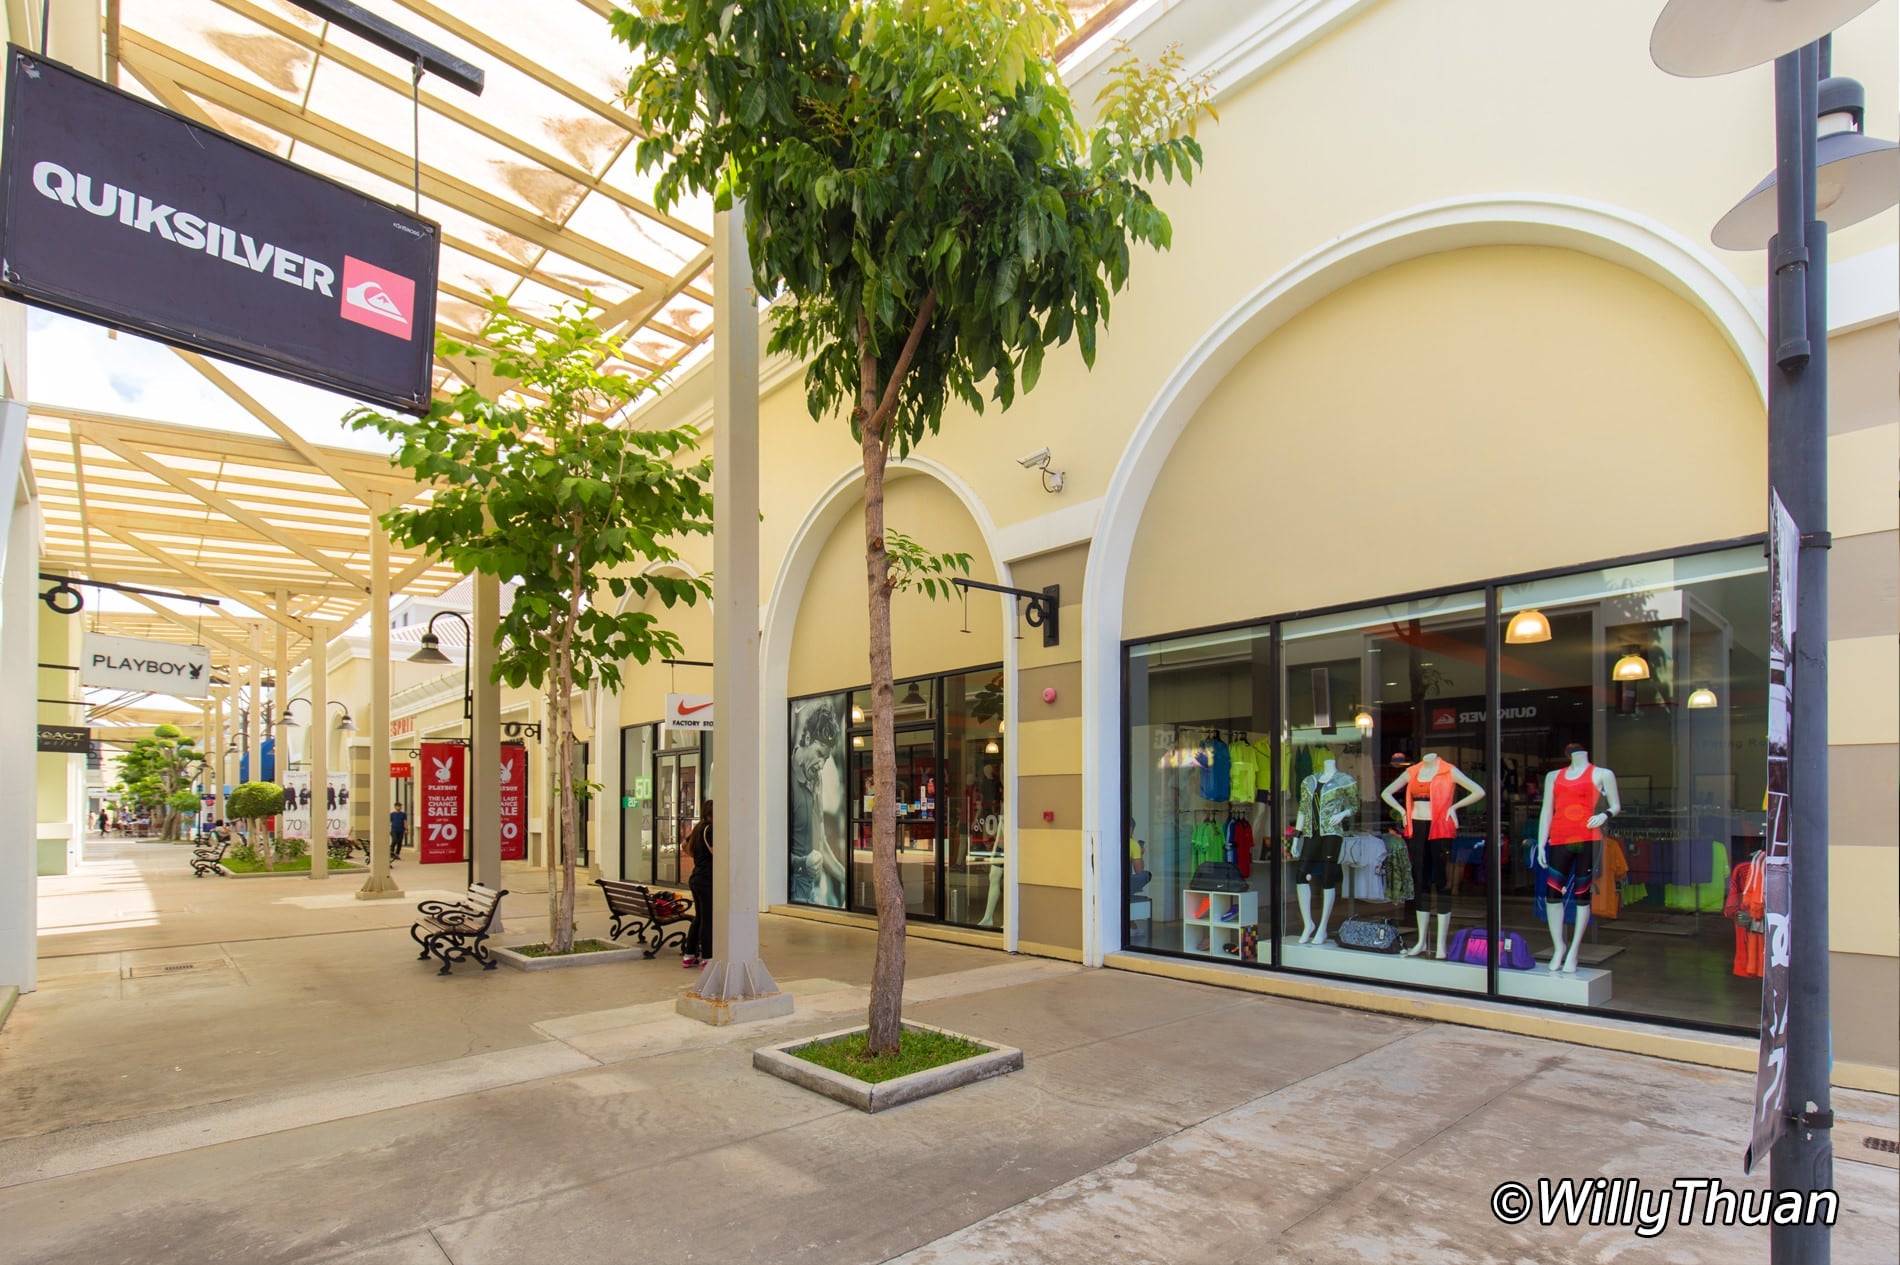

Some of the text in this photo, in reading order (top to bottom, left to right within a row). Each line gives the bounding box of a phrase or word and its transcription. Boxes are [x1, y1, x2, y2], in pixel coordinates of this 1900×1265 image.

[32, 160, 335, 298] QUIKSILVER
[92, 654, 186, 676] PLAYBOY
[635, 778, 651, 800] 50
[428, 807, 458, 816] SALE
[428, 823, 457, 841] 70
